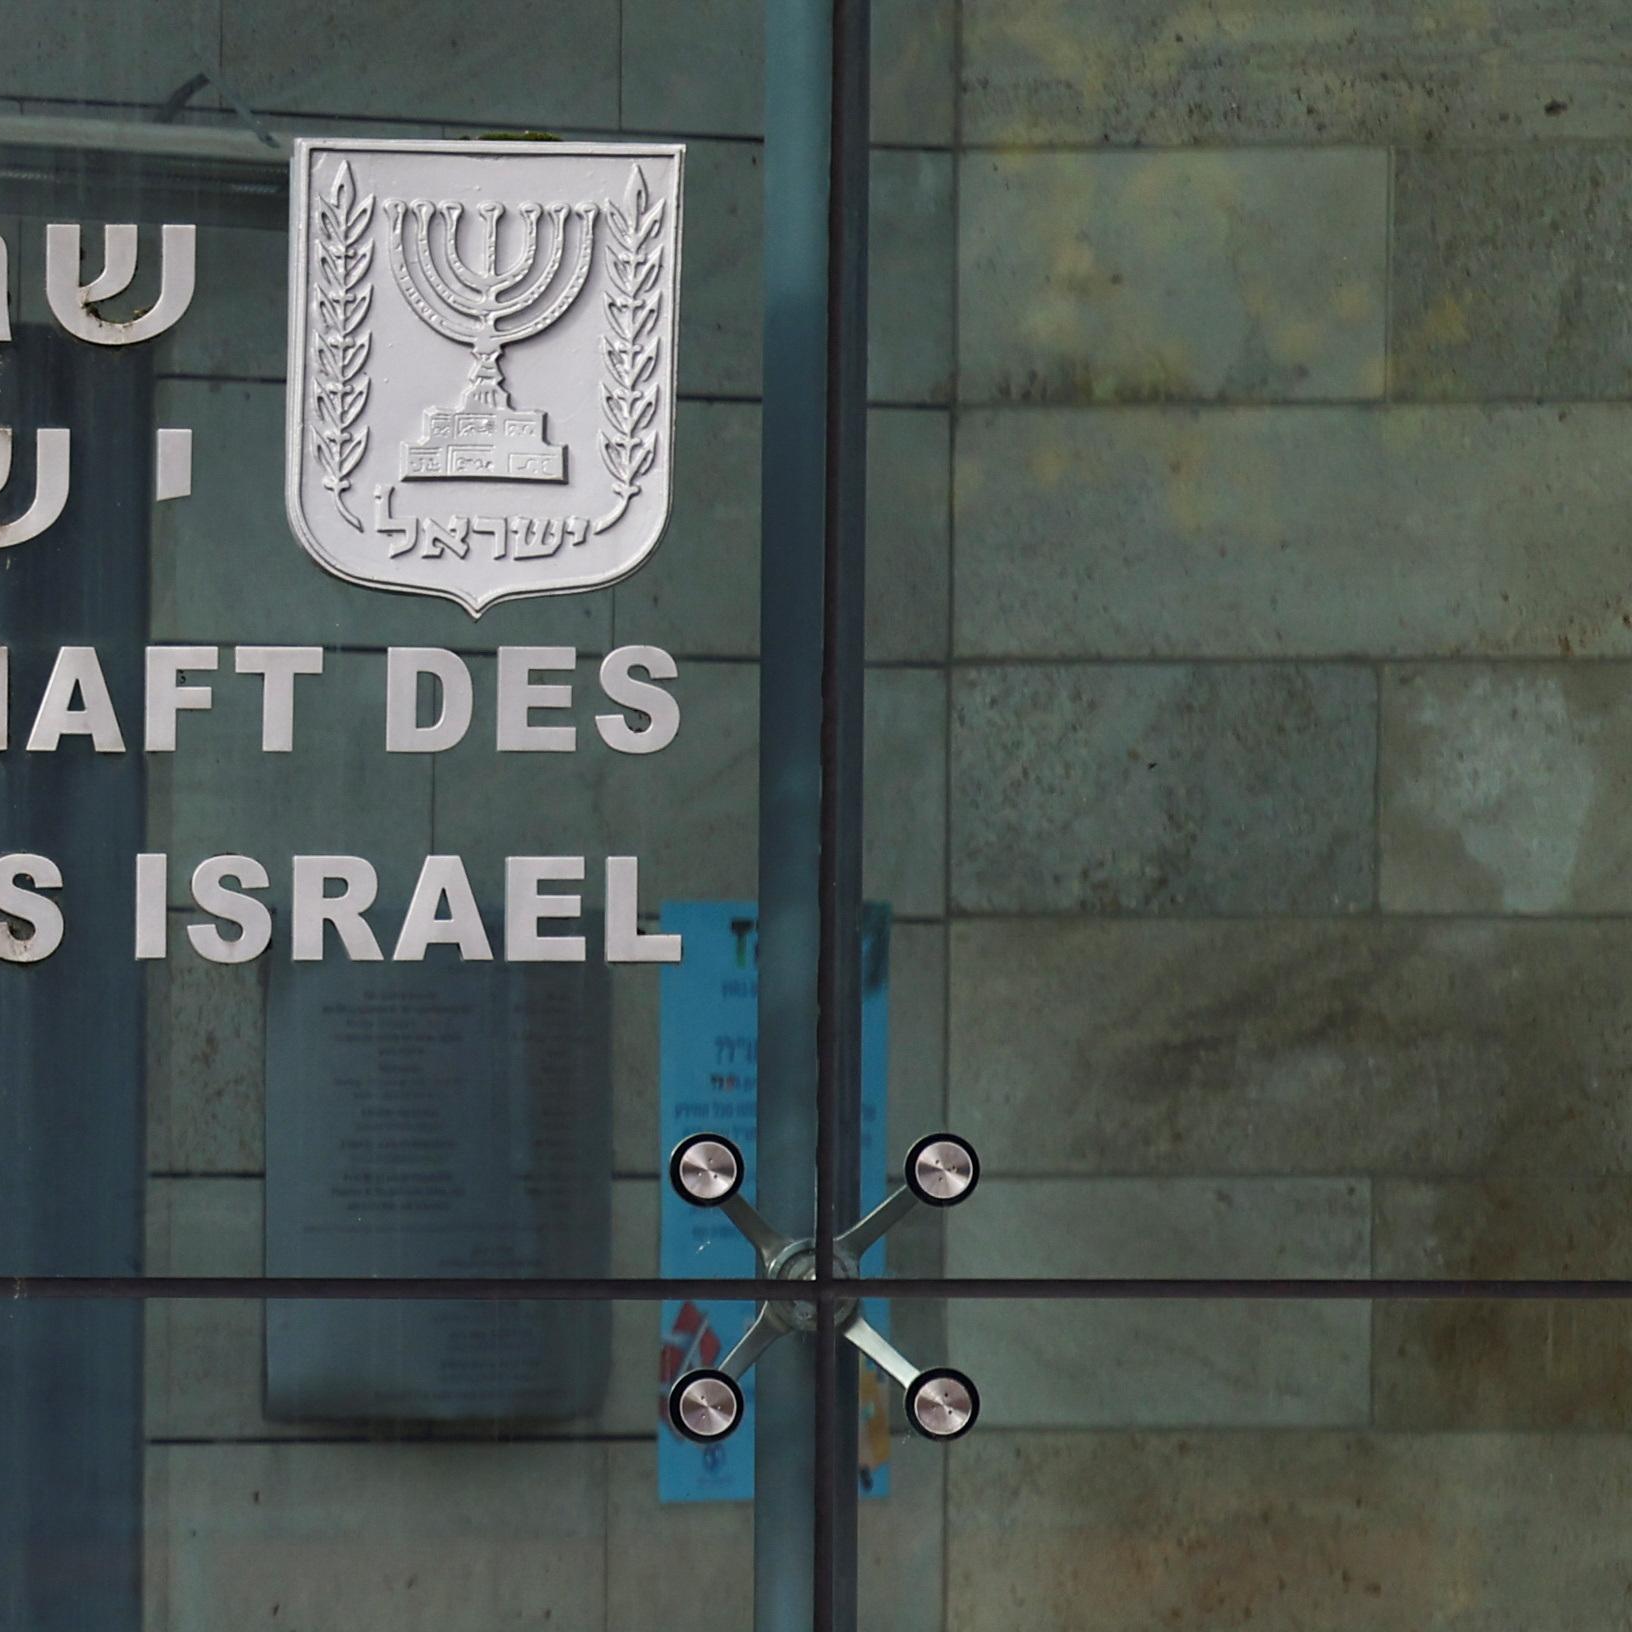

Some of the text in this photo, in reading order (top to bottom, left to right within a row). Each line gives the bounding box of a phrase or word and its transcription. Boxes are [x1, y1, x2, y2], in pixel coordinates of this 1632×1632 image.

[375, 483, 590, 561] ישראל
[385, 644, 680, 754] DES
[135, 853, 682, 963] ISRAEL
